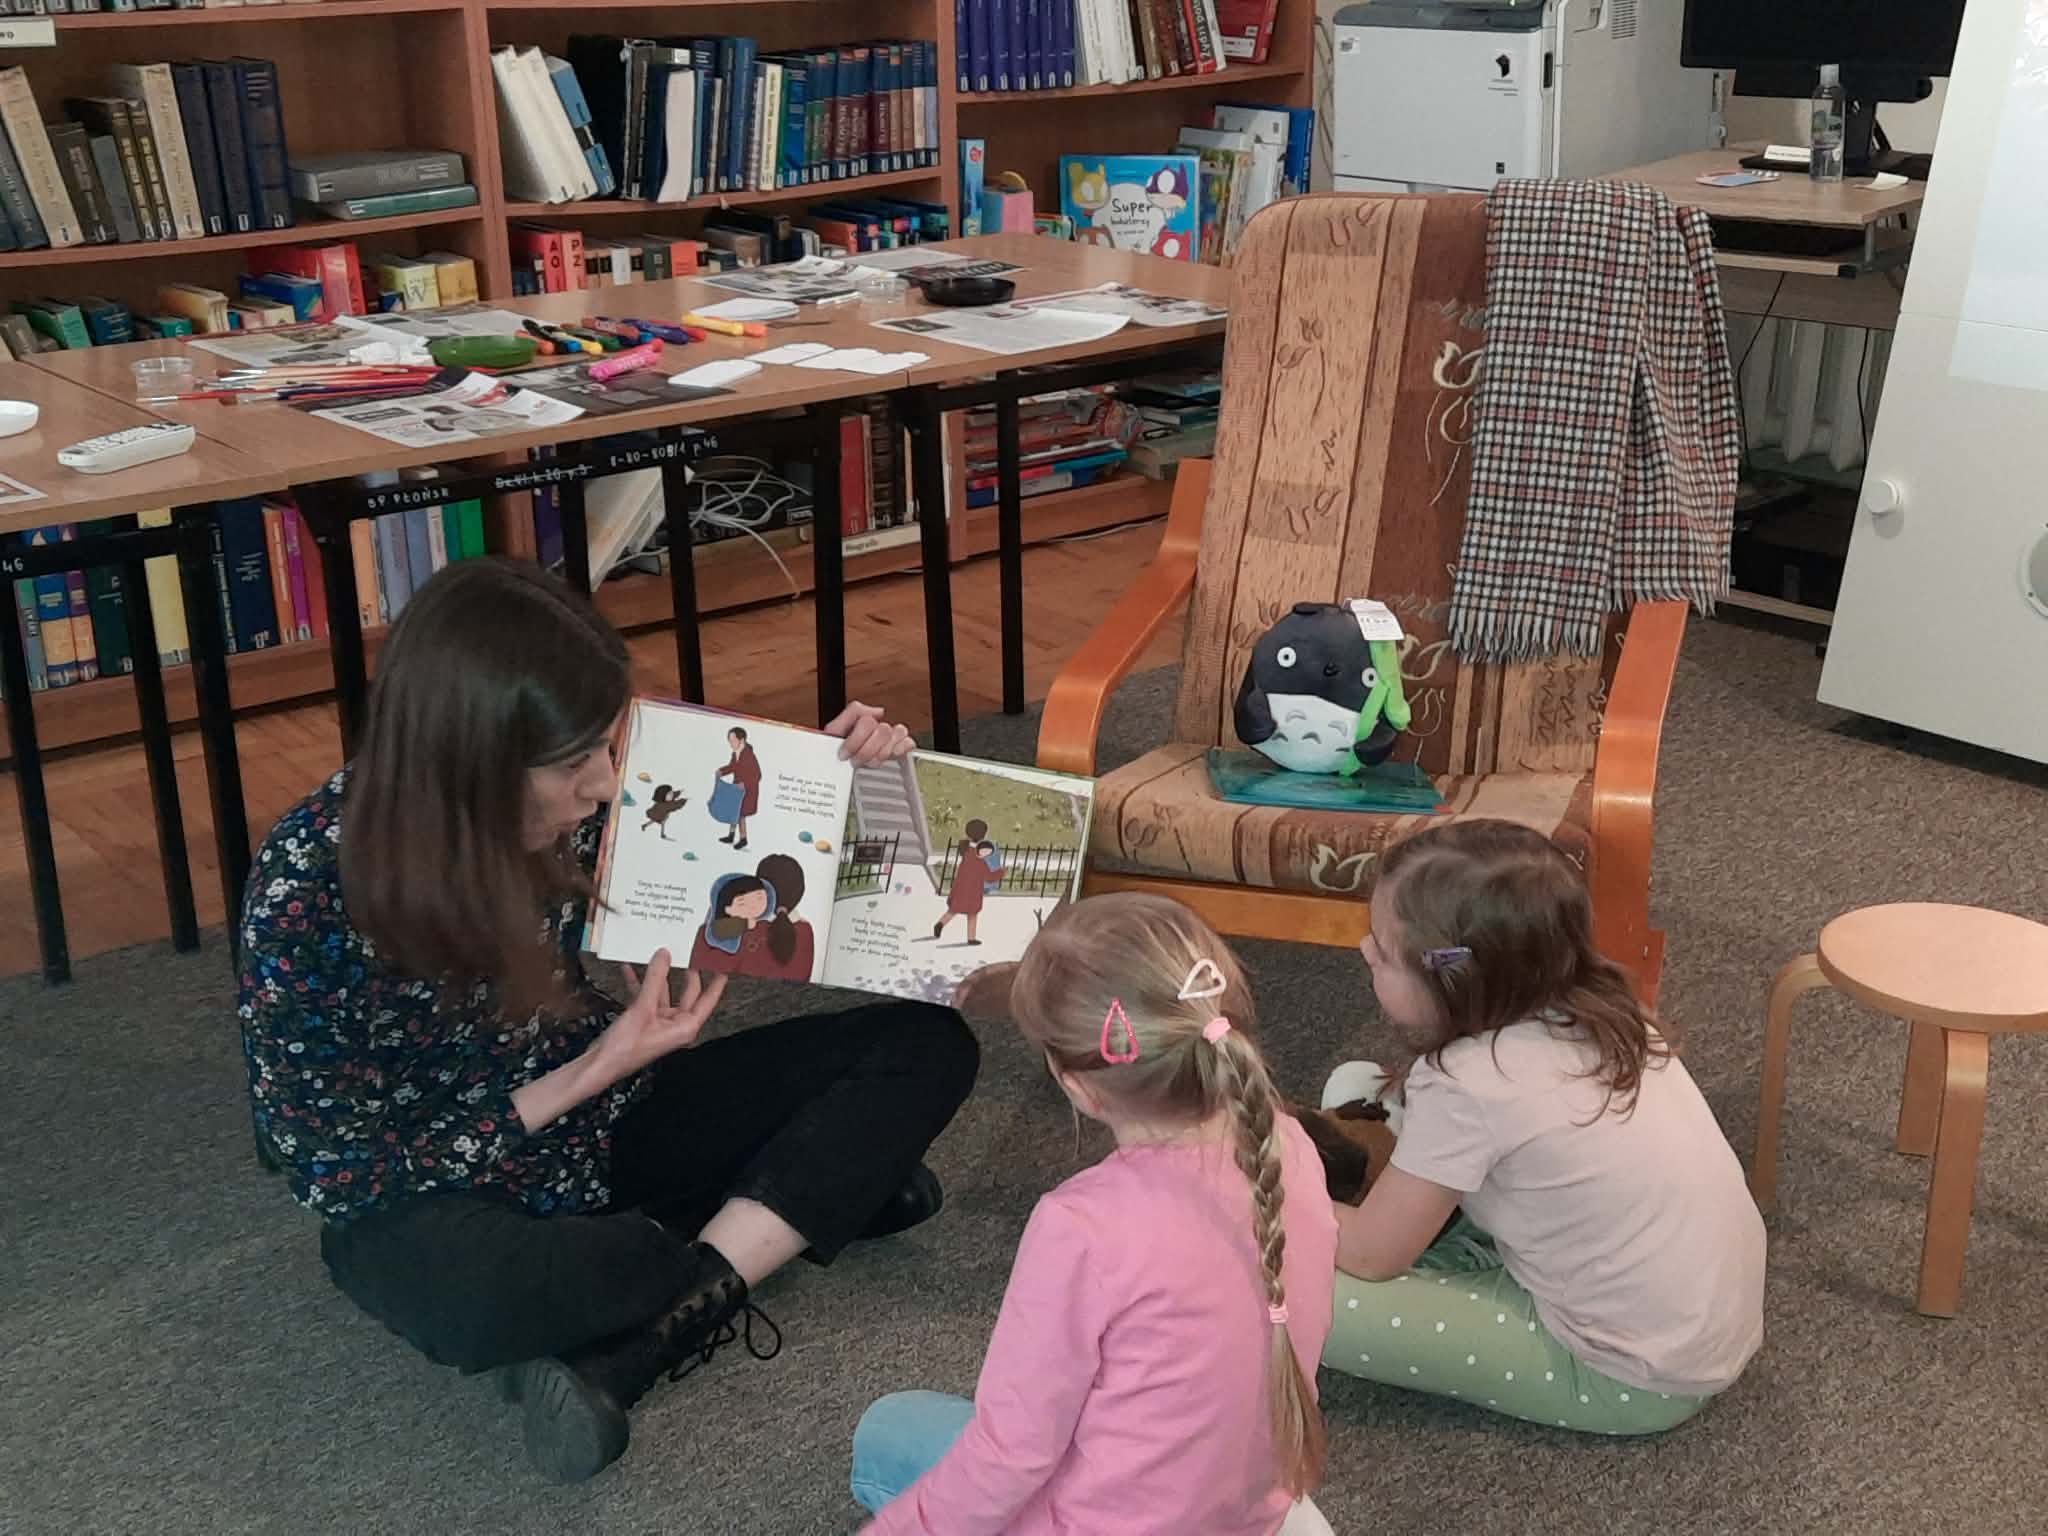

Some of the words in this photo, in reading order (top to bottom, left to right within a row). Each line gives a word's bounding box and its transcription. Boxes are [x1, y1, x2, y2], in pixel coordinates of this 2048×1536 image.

[1111, 198, 1152, 216] Super
[549, 240, 559, 253] A
[571, 239, 580, 251] P
[2, 557, 24, 573] 46
